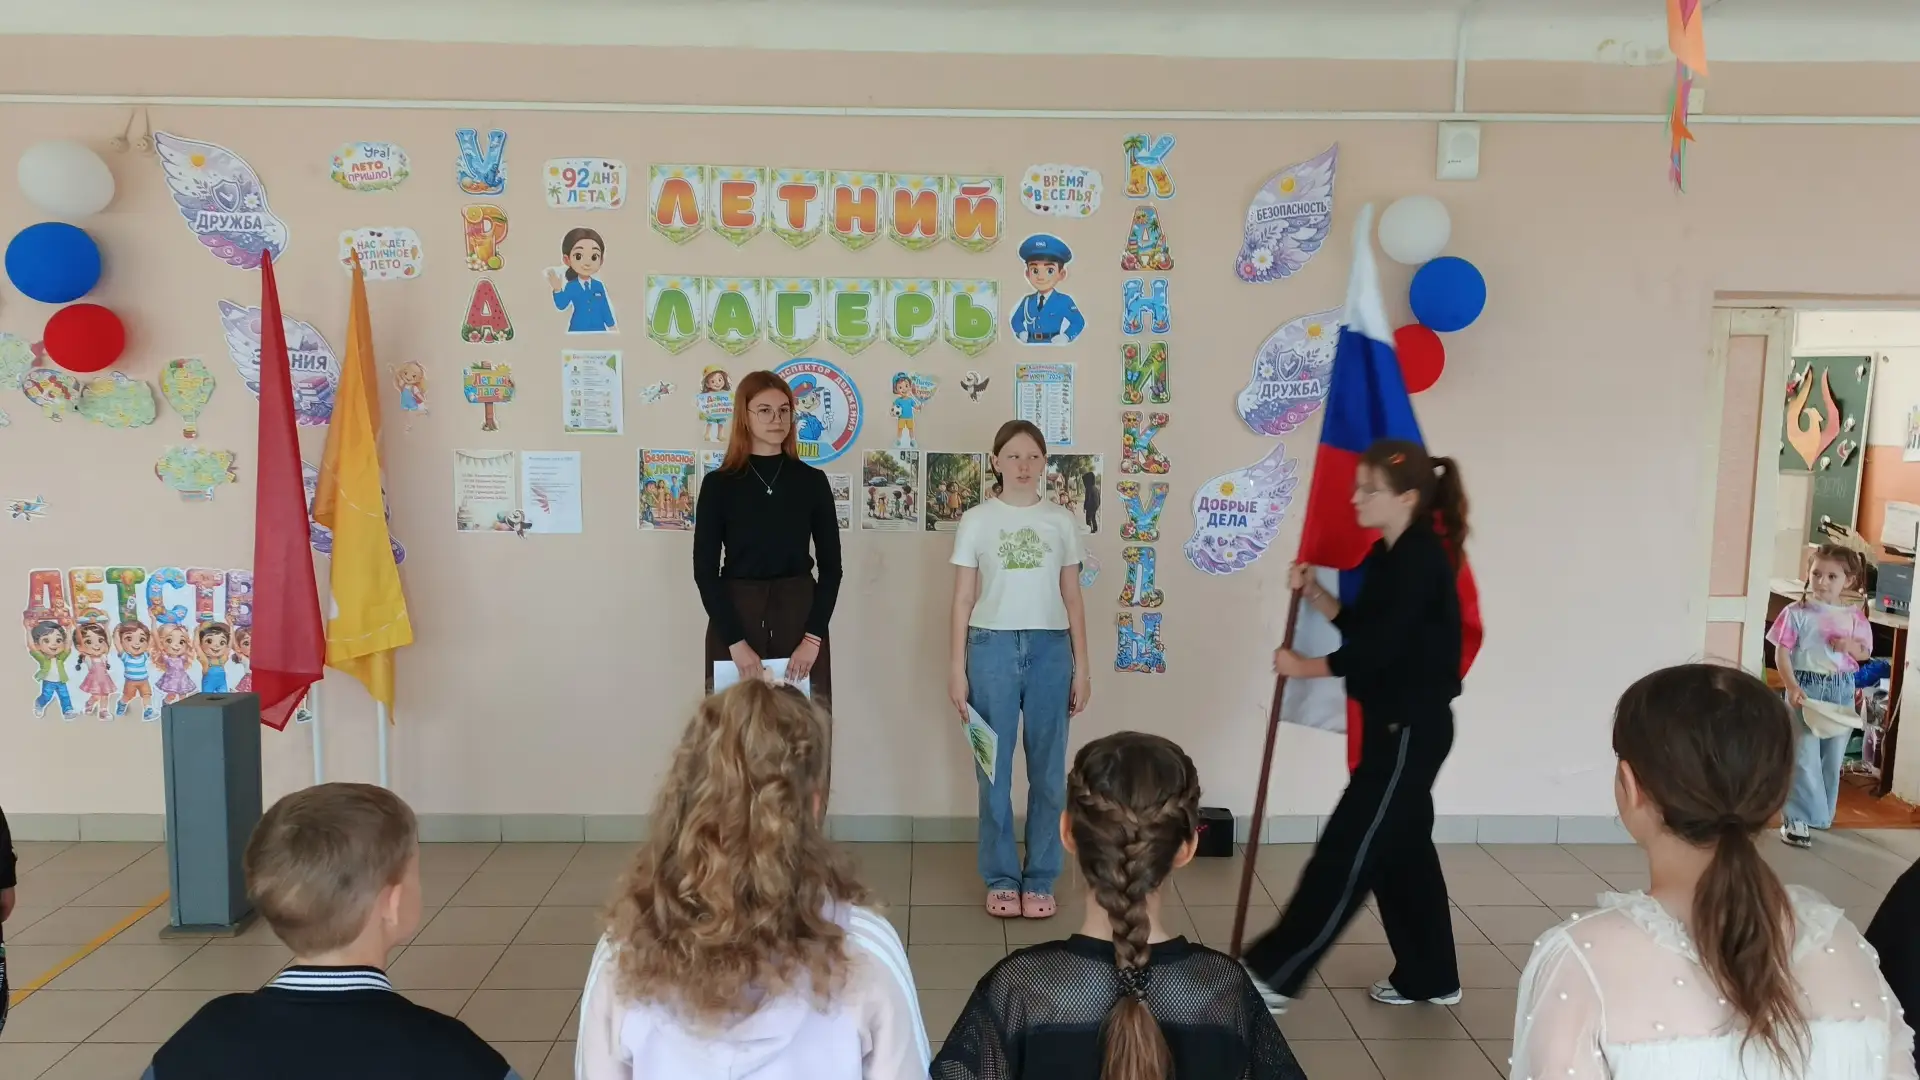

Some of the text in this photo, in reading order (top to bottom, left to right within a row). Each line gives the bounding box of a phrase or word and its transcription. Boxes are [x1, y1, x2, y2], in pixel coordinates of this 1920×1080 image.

[364, 146, 390, 160] Ура!
[348, 167, 392, 181] ПРИШЛО!
[351, 161, 384, 172] ЛЕТО
[562, 168, 620, 188] 92 ДНЯ
[1043, 175, 1084, 188] ВРЕМЯ
[567, 189, 606, 202] ЛЕТА
[1034, 189, 1093, 202] ВЕСЕЛЬЯ
[655, 177, 999, 240] ЛЕТНИЙ
[1256, 201, 1327, 221] БЕЗОПАСНОСТЬ
[196, 212, 263, 231] ДРУЖБА
[357, 240, 376, 250] НАС
[369, 259, 401, 270] ЛЕТО
[652, 288, 993, 339] ЛАГЕРЬ
[252, 348, 328, 370] ЗНИЯ
[778, 364, 859, 431] НСПЕКТОР ДВИЖЕНИЯ
[1260, 381, 1321, 400] ДРУЖБА
[1114, 132, 1176, 674] КАНИКУЛЫ
[644, 451, 695, 464] Безопасное
[655, 464, 681, 474] лето
[1197, 496, 1258, 514] ДОБРЫЕ
[1206, 512, 1248, 528] ДЕЛА
[23, 567, 254, 626] ДЕТСТВ
